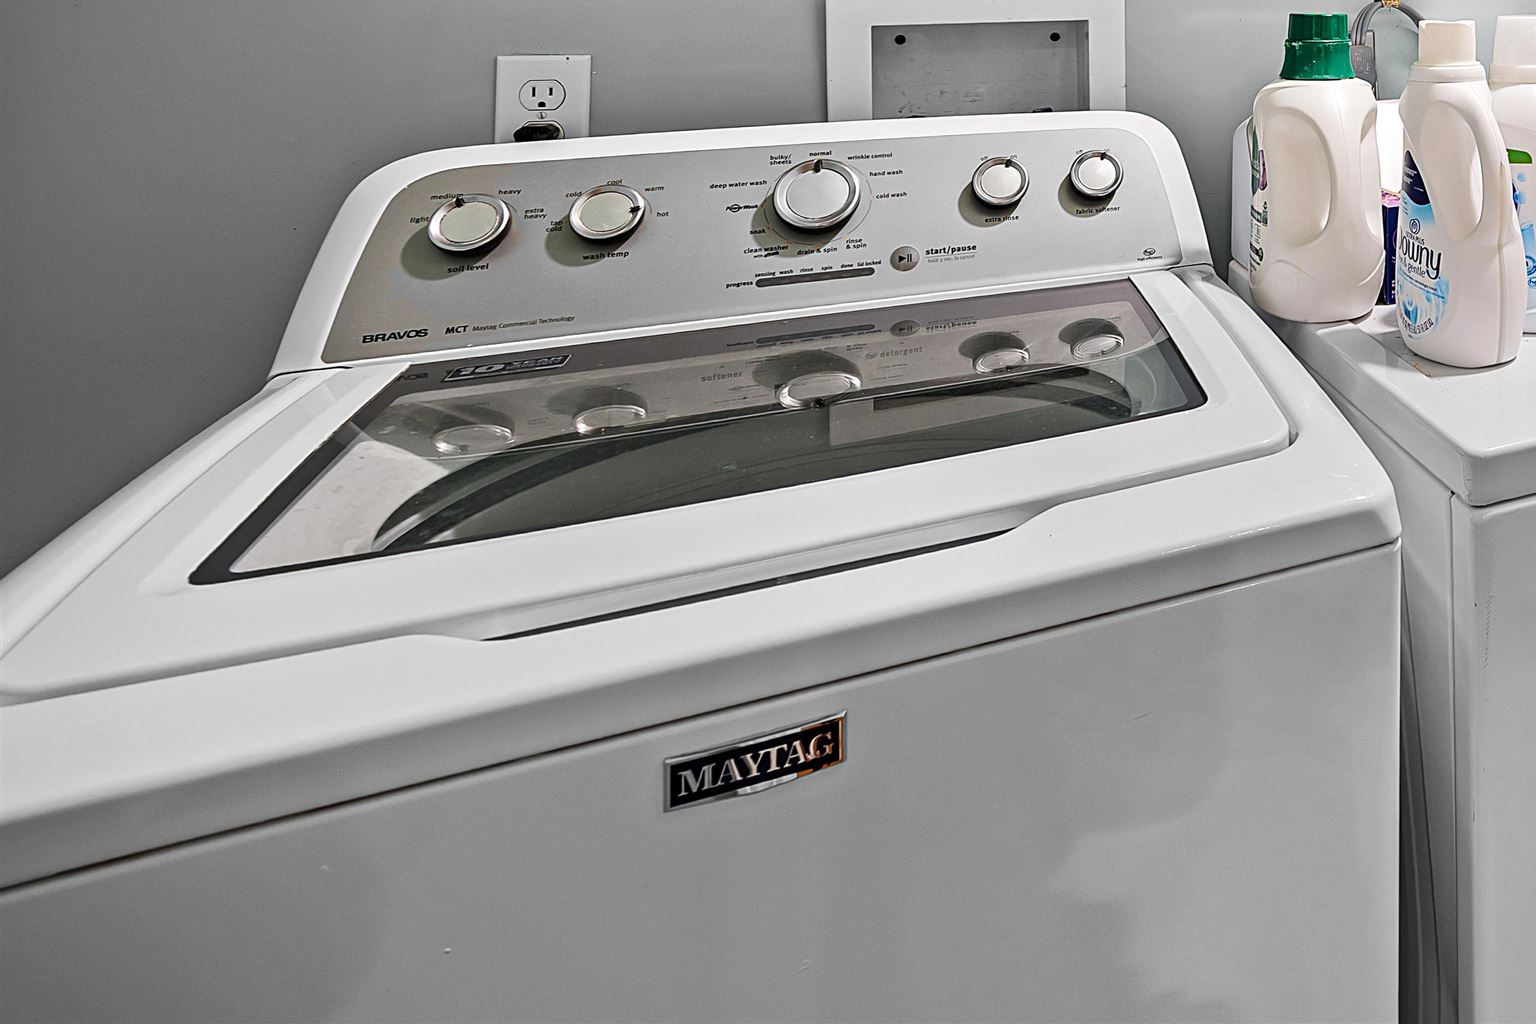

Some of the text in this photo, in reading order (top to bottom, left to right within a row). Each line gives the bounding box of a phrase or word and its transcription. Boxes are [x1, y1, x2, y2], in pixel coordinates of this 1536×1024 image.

[606, 178, 623, 186] cool
[498, 188, 522, 196] heavy
[524, 212, 548, 220] heavy
[1075, 207, 1094, 215] fabric
[410, 216, 429, 224] light
[984, 214, 1020, 224] extra rinse
[743, 244, 789, 254] clean washer
[797, 248, 815, 256] drain
[823, 246, 838, 254] spin
[925, 244, 977, 256] start/pause
[582, 250, 630, 261] wash temp
[447, 263, 489, 274] soil level
[725, 280, 754, 289] progress
[362, 328, 428, 344] BRAVOS
[445, 325, 469, 335] MCT
[498, 318, 538, 329] Commercial
[538, 315, 576, 325] Technology
[459, 363, 505, 376] 10
[701, 370, 743, 383] softener
[677, 731, 835, 798] MAYTAG
